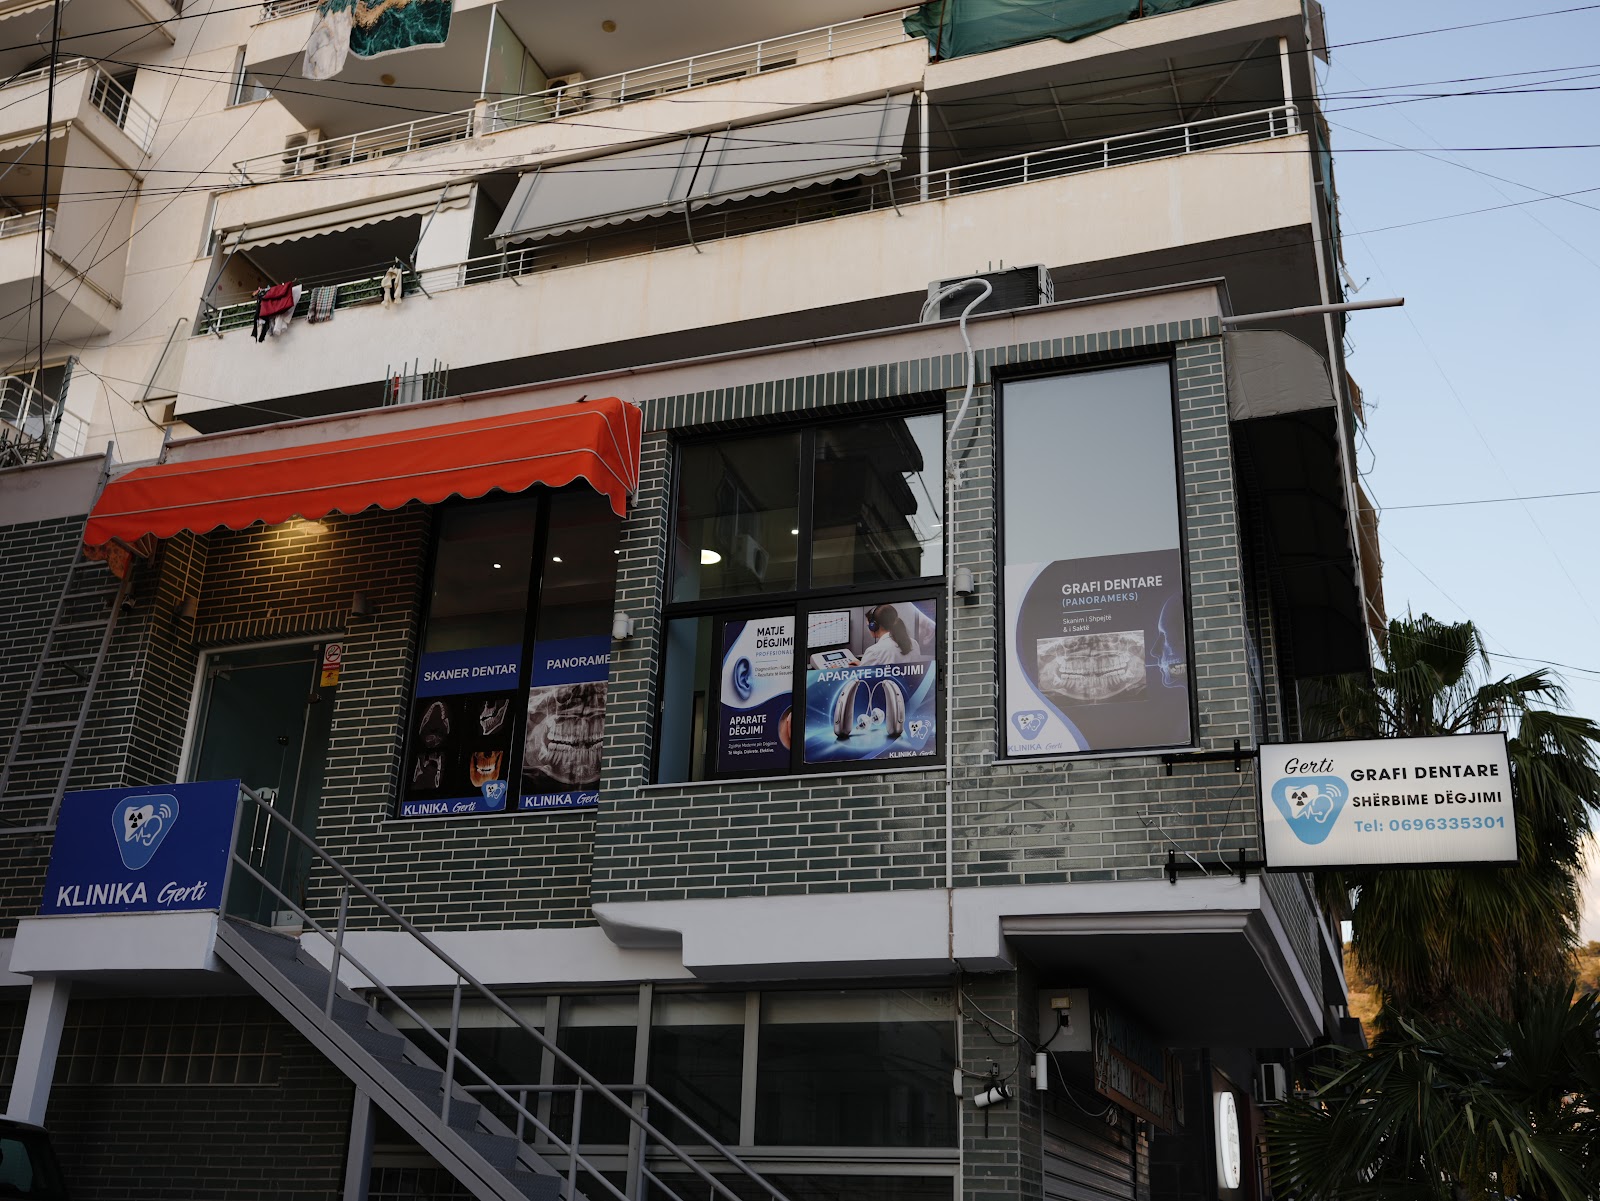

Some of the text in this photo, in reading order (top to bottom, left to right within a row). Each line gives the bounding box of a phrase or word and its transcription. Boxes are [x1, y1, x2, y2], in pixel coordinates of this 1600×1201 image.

[1061, 575, 1163, 596] GRAFI DENTARE
[1062, 592, 1138, 608] (PANORAMEKS)
[1062, 615, 1085, 625] Skanim
[757, 625, 785, 637] MATJE
[756, 637, 793, 649] DËGJIMI
[546, 653, 611, 670] PANORAME
[423, 663, 517, 682] SKANER DENTAR
[817, 662, 924, 683] APARATE DËGJIMI
[729, 714, 767, 725] APARATE
[729, 724, 763, 736] DËGJIMI
[889, 750, 917, 759] KLINIKA
[1008, 742, 1042, 753] KLINIKA
[1284, 757, 1335, 775] Gerti
[1350, 763, 1499, 782] GRAFI DENTARE
[525, 794, 573, 808] KLINIKA
[1352, 790, 1502, 808] SHËRBIME DËGJIMI
[403, 801, 476, 816] KLINIKA Gerti
[1354, 816, 1505, 833] Tel: 0696335301
[57, 881, 208, 907] KLINIKA Gerti
